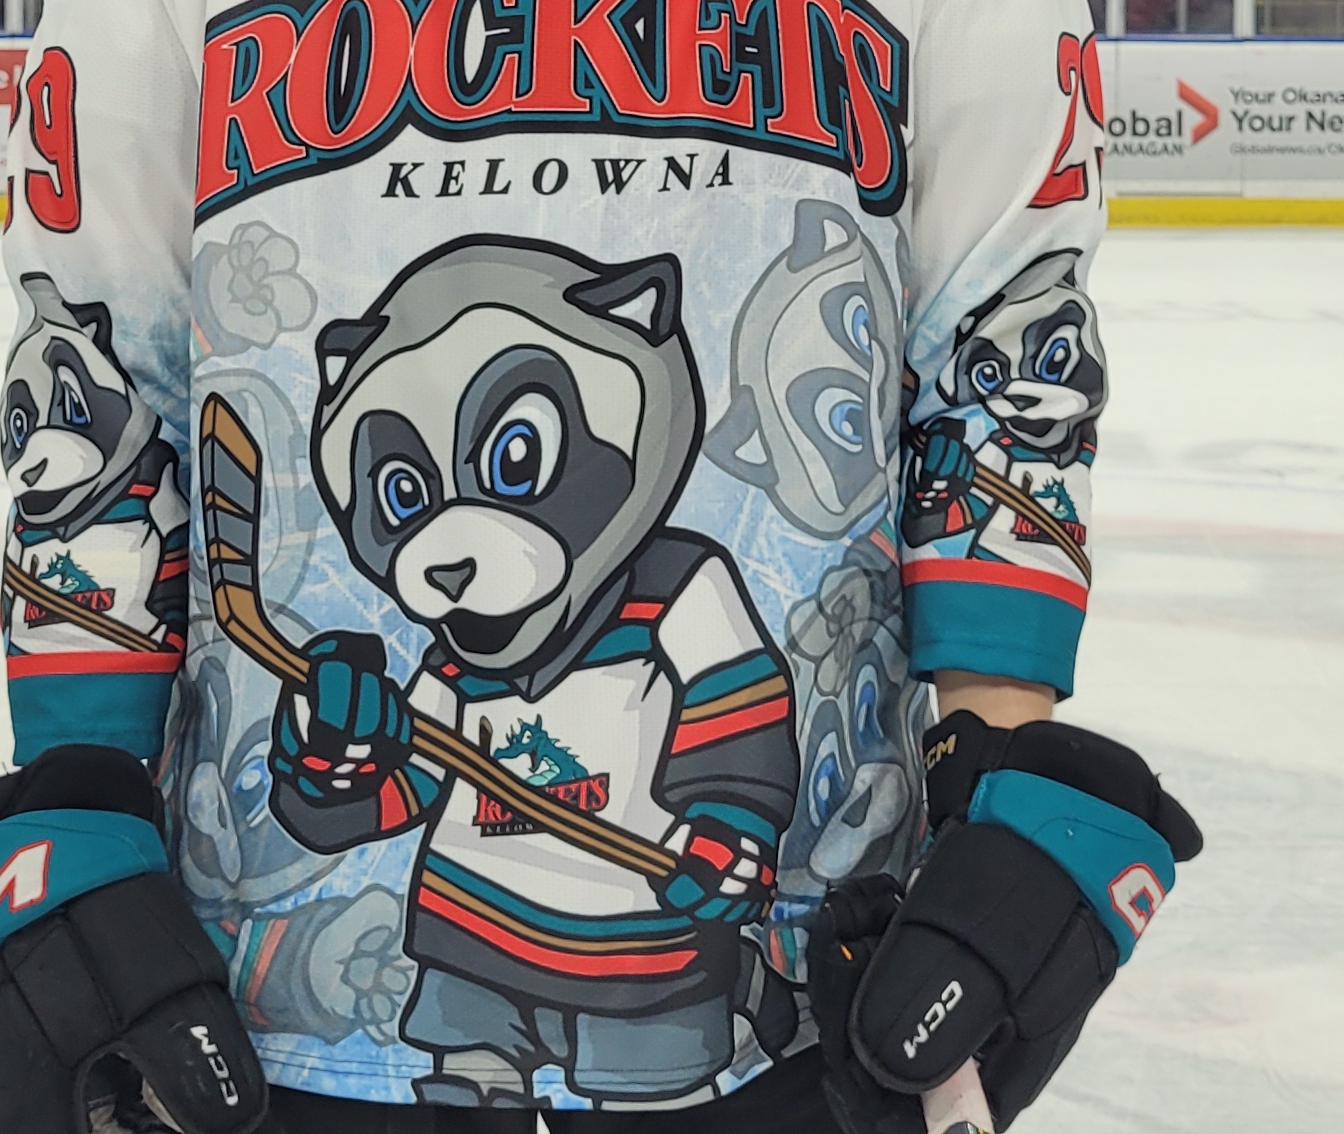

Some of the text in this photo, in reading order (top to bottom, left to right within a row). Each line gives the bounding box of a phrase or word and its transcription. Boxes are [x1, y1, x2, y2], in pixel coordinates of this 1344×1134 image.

[1229, 87, 1275, 104] Your
[1231, 109, 1303, 133] Your
[381, 147, 735, 199] KELOWNA
[902, 979, 964, 1060] CCM
[189, 1023, 240, 1107] CCM
